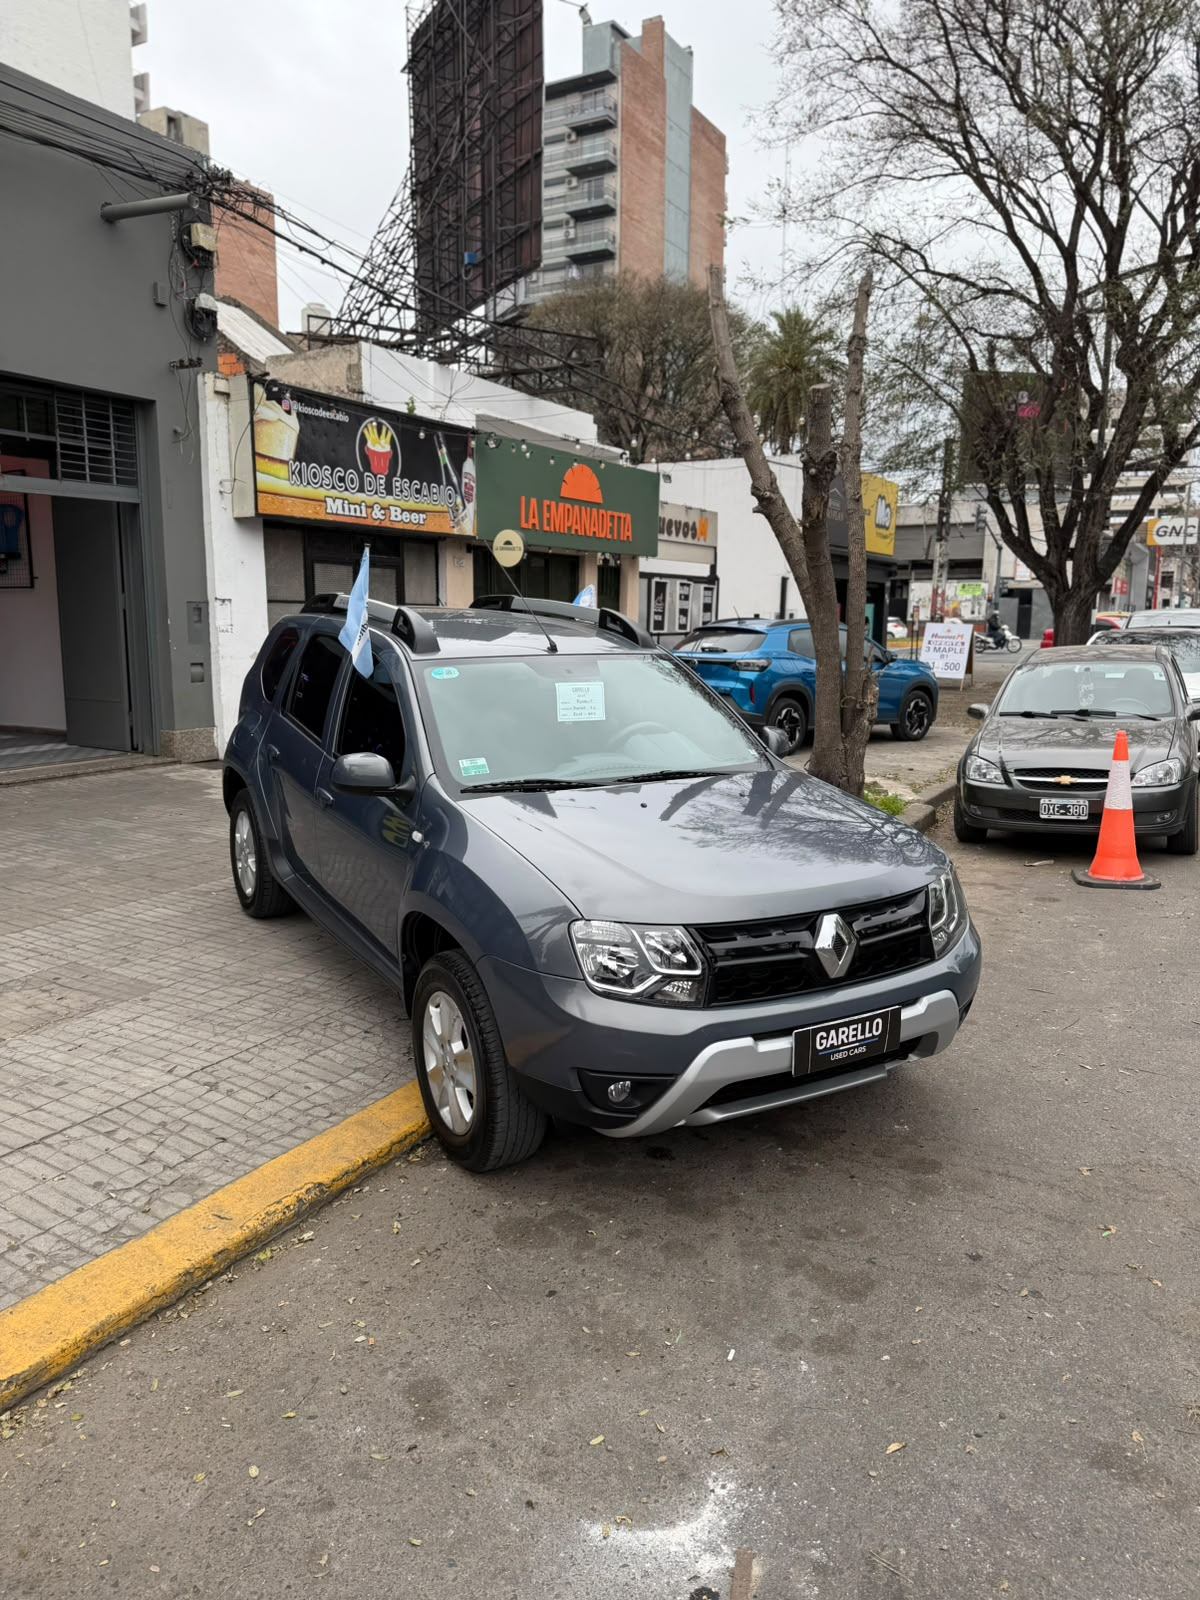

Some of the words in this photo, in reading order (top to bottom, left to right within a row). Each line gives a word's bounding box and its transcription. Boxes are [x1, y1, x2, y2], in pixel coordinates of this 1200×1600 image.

[292, 400, 350, 423] @kioscodeescabio
[288, 459, 360, 493] KIOSCO
[364, 473, 387, 498] DE
[392, 476, 456, 507] ESCABIO
[325, 496, 367, 519] Mini
[371, 502, 386, 522] &
[390, 505, 427, 525] Beer
[520, 495, 540, 530] LA
[542, 499, 633, 542] EMPANADETTA
[1156, 524, 1197, 538] GNC
[815, 1017, 883, 1050] GARELLO
[830, 1050, 848, 1060] USED
[849, 1046, 867, 1056] CARS
